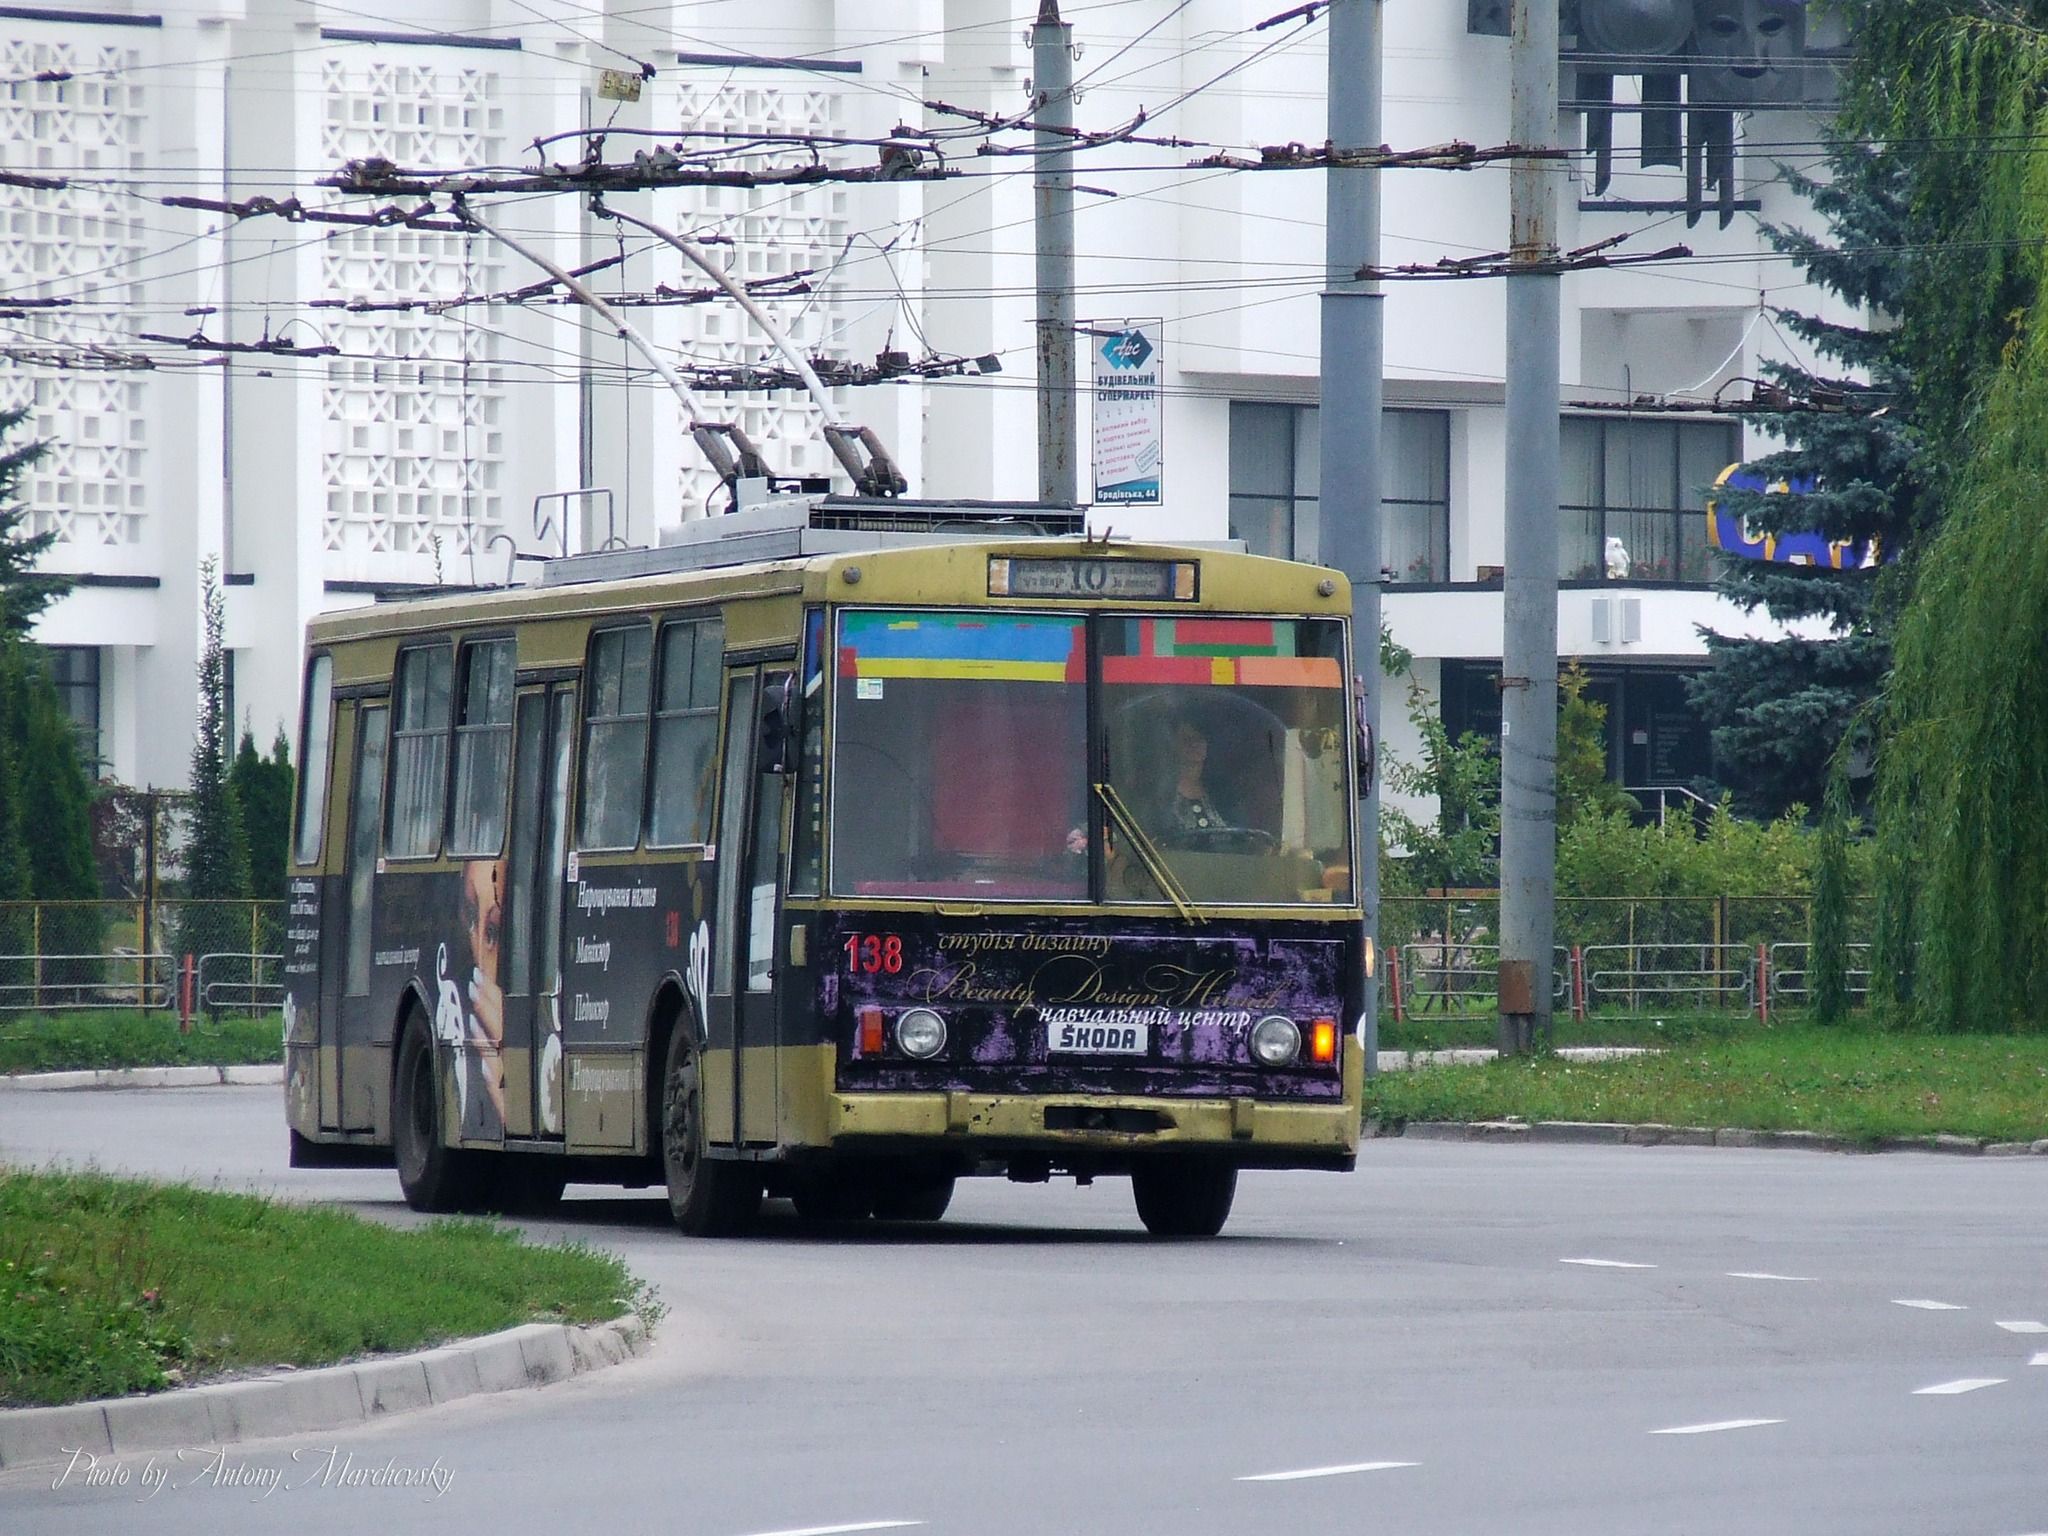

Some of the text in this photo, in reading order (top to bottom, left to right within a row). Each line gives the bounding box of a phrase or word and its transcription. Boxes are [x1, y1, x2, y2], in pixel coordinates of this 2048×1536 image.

[1098, 372, 1156, 388] БУДІВЕЛЬНИЙ
[1098, 390, 1155, 401] СУПЕРМАРКЕТ
[1145, 489, 1156, 497] 44
[1071, 560, 1108, 591] 10
[575, 935, 610, 971] Манікюр
[844, 935, 902, 974] 138
[938, 930, 1016, 957] студія
[907, 960, 1036, 1018] Beauty
[1029, 955, 1158, 1010] Design
[1038, 1007, 1250, 1034] навчальний центр
[1060, 1025, 1137, 1049] ŠKODA
